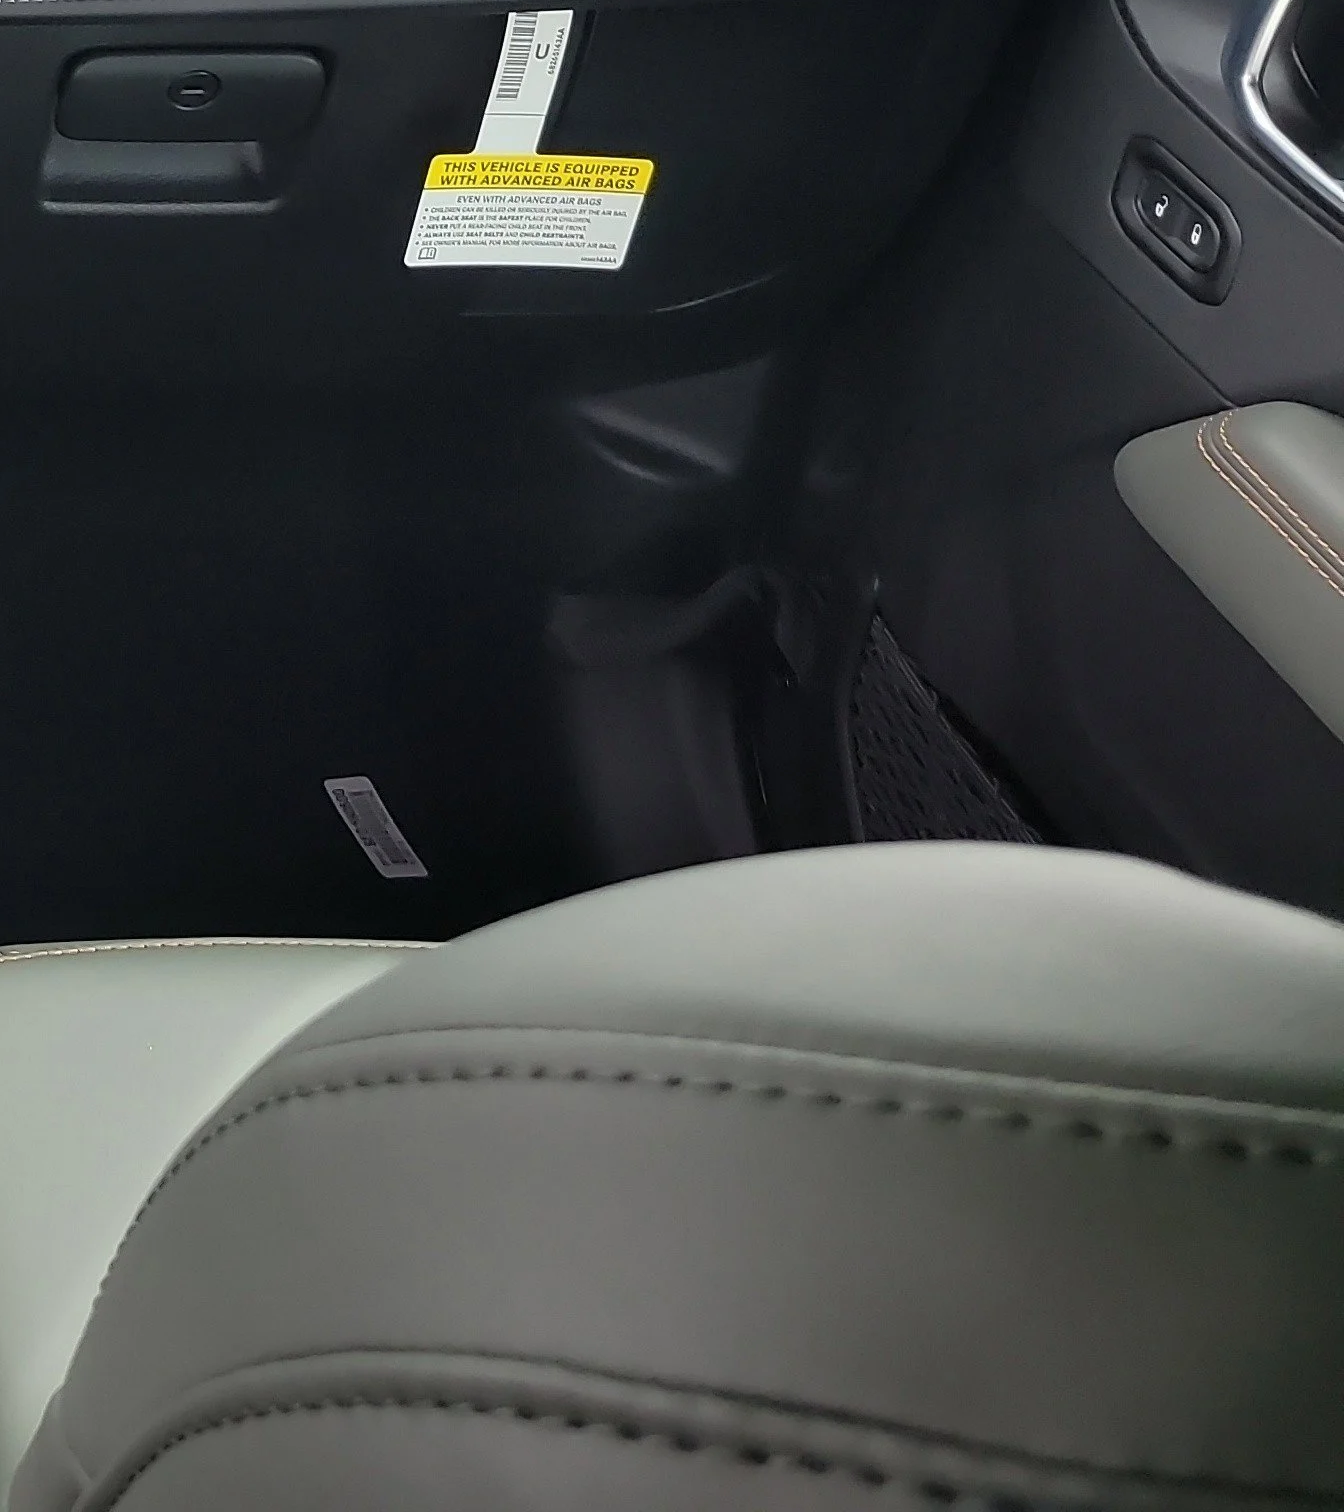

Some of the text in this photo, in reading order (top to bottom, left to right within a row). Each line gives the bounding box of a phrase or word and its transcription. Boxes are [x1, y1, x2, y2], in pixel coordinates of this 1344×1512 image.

[535, 43, 550, 59] U
[444, 162, 640, 177] THIS VEHICLE IS EQUIPPED
[440, 175, 636, 189] WITH ADVANCED AIR BAGS
[456, 196, 602, 206] EVEN WITH ADVANCED AIR BAGS
